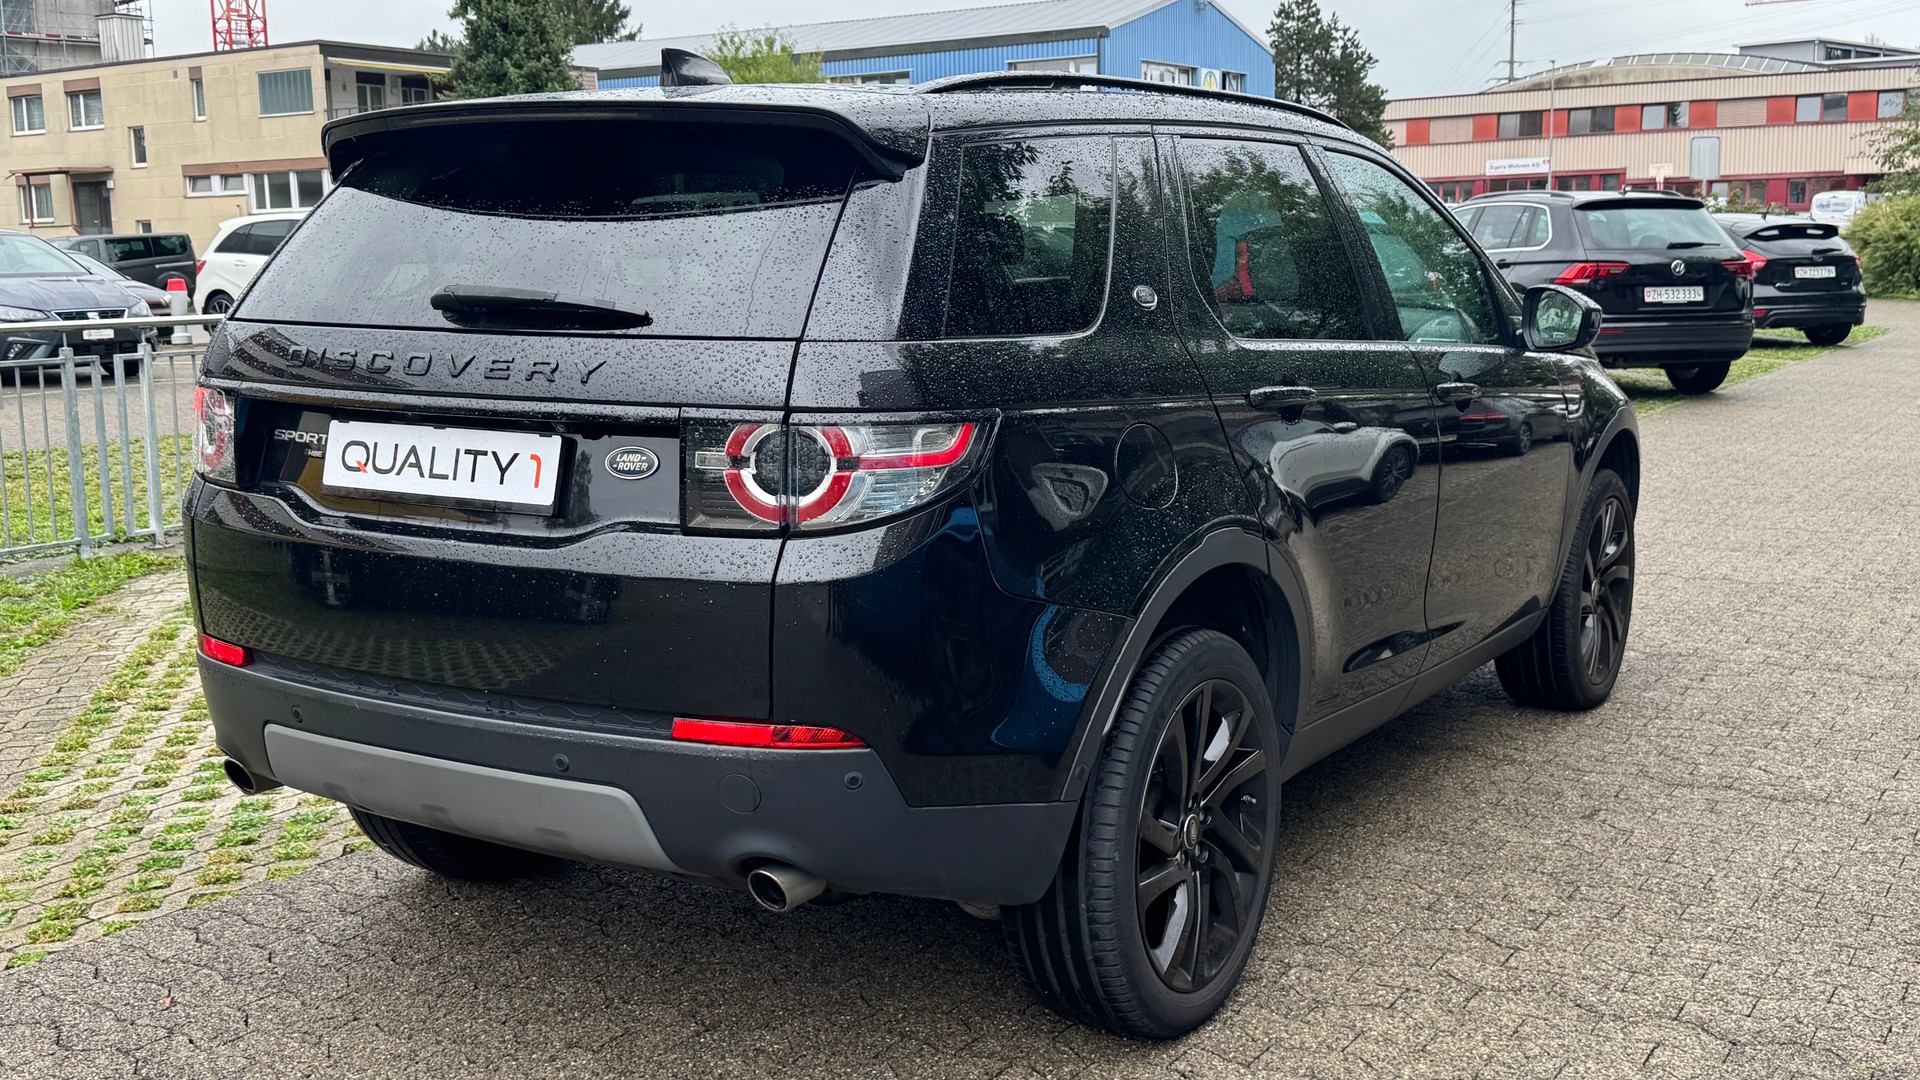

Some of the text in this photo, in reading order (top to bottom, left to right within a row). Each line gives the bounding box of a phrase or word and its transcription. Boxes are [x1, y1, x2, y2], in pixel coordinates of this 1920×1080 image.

[286, 345, 608, 384] DISCOVERY
[273, 428, 328, 446] SPORT
[341, 440, 542, 489] QUALITY 1
[616, 453, 642, 462] LAND
[617, 462, 648, 471] ROVER
